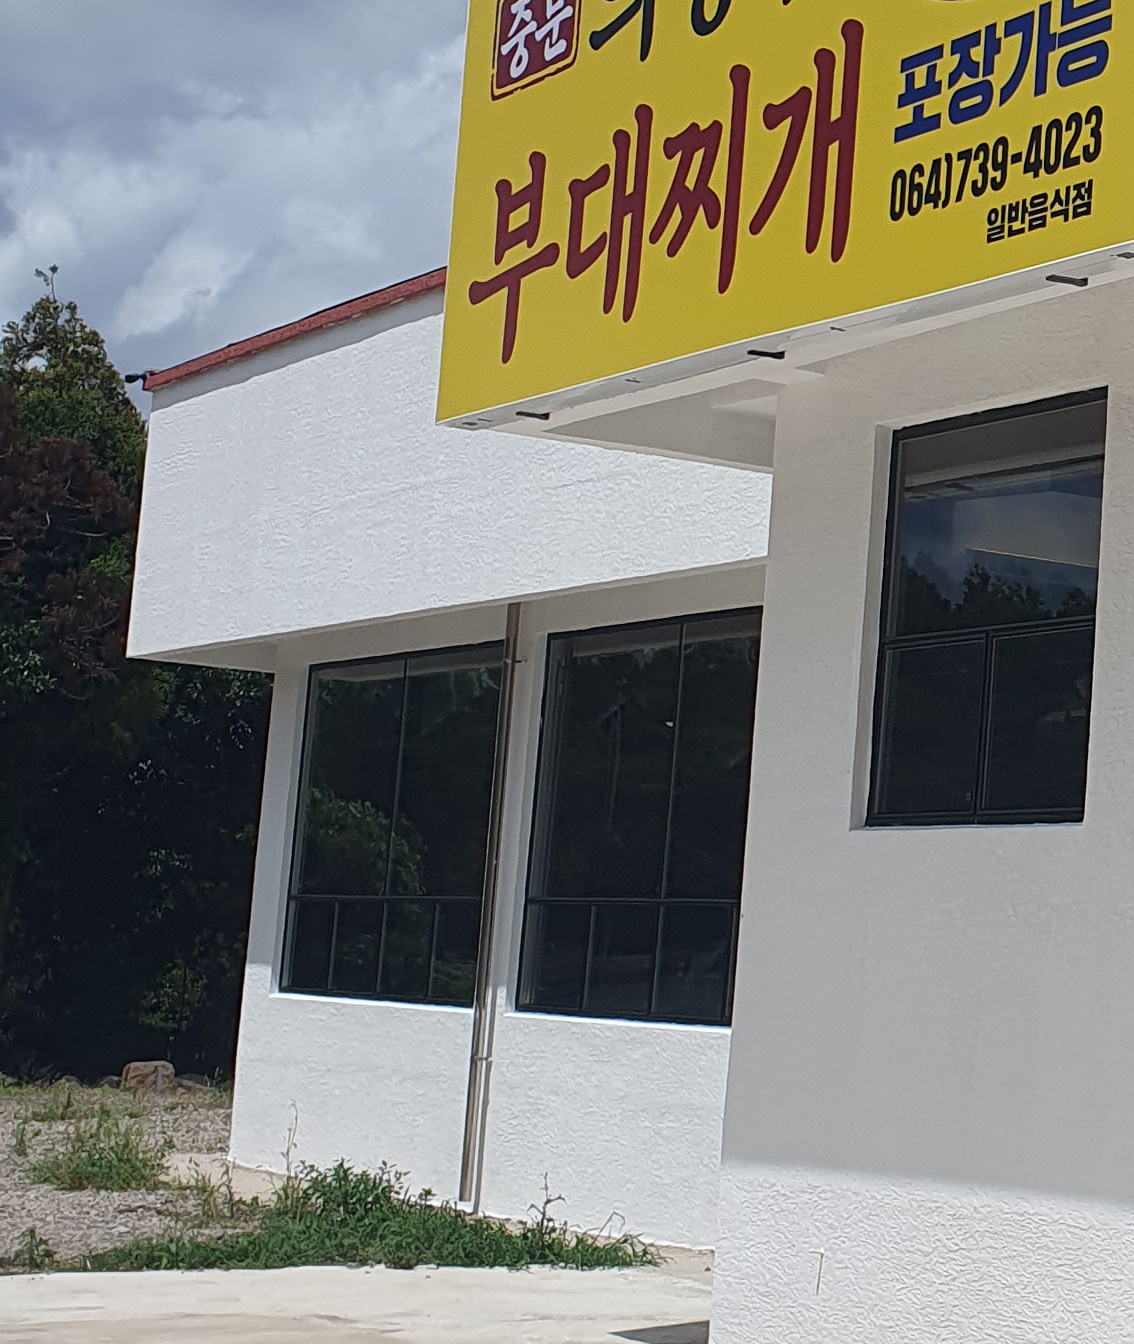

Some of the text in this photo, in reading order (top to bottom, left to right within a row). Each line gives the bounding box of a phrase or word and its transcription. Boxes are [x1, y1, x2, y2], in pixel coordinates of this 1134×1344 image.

[468, 19, 864, 365] 부대찌개
[889, 105, 1103, 222] 064)739-4023
[986, 179, 1093, 244] 일반음식점
